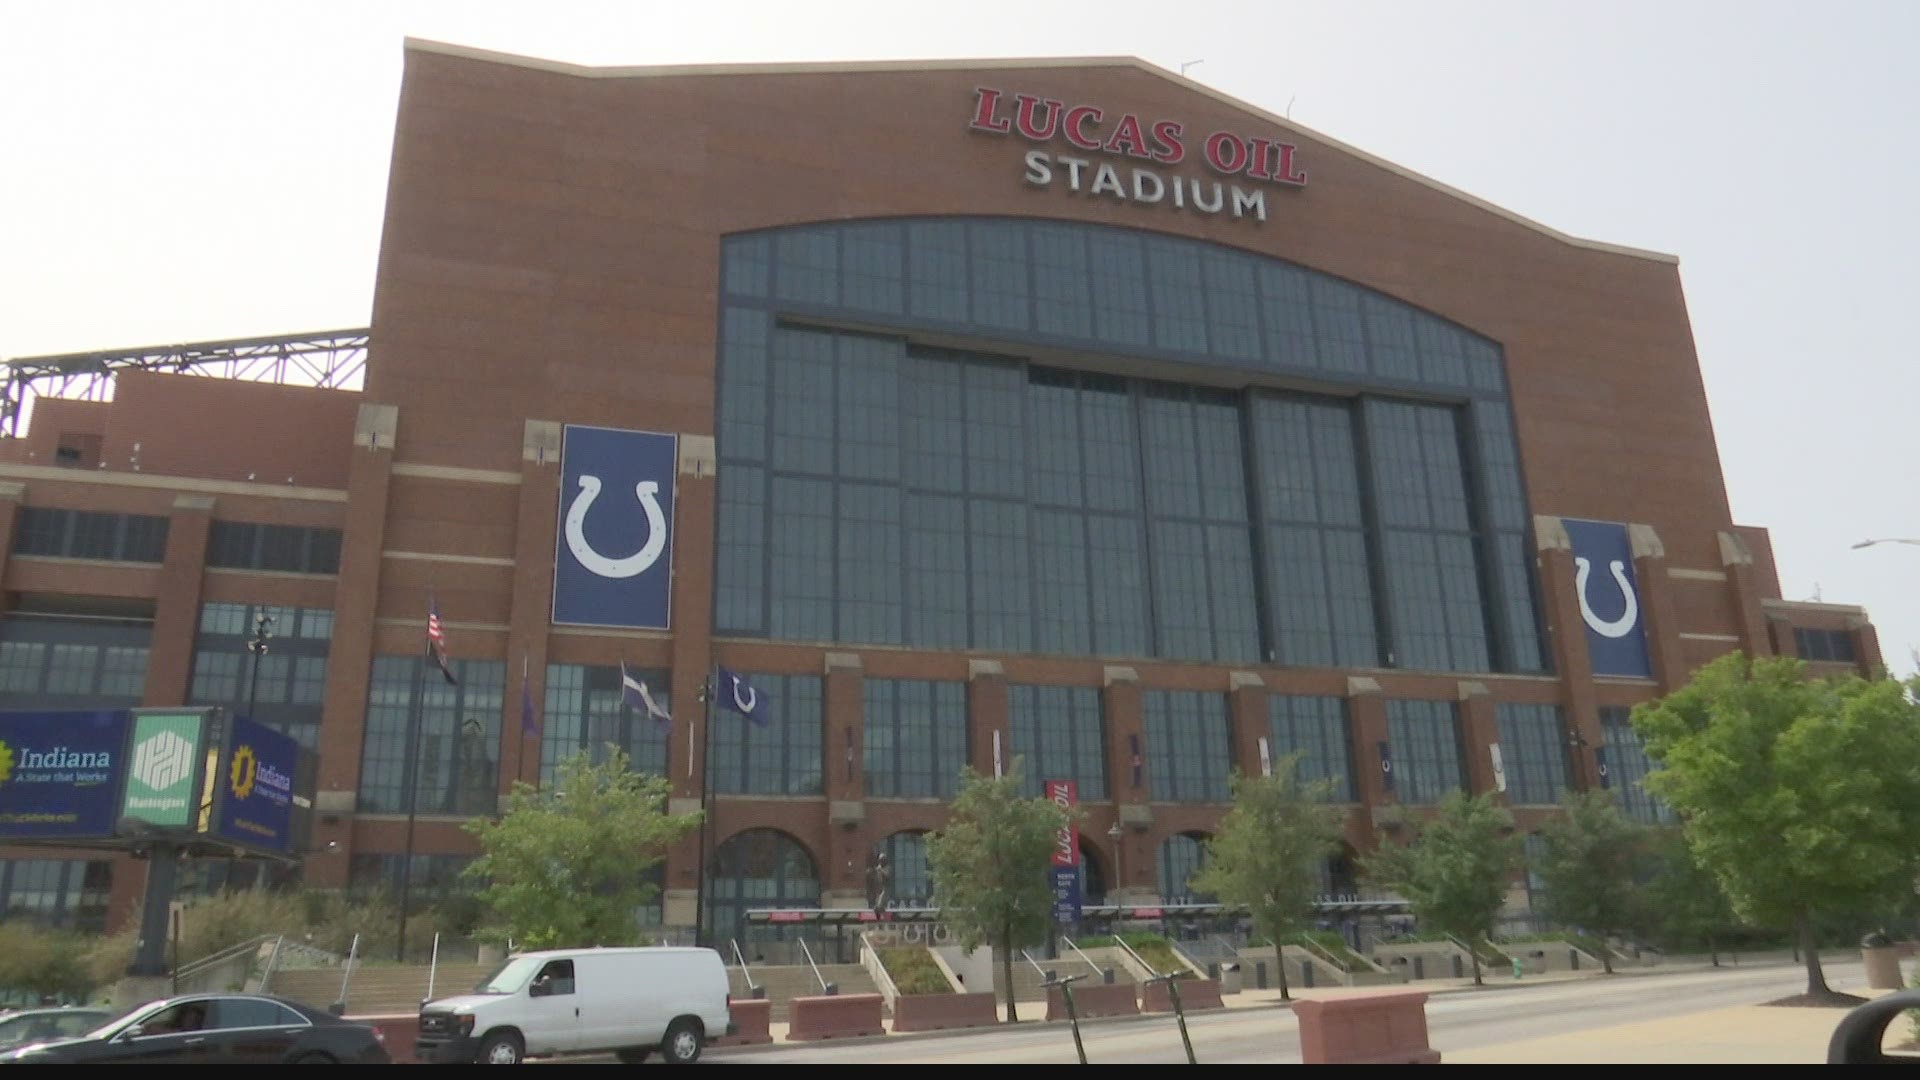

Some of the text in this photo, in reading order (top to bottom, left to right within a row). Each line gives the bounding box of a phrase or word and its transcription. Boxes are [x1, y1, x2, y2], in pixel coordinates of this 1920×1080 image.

[970, 87, 1307, 185] LUCAS OIL
[1024, 151, 1267, 222] STADIUM
[17, 747, 110, 768] Indiana
[256, 761, 290, 791] Indiana
